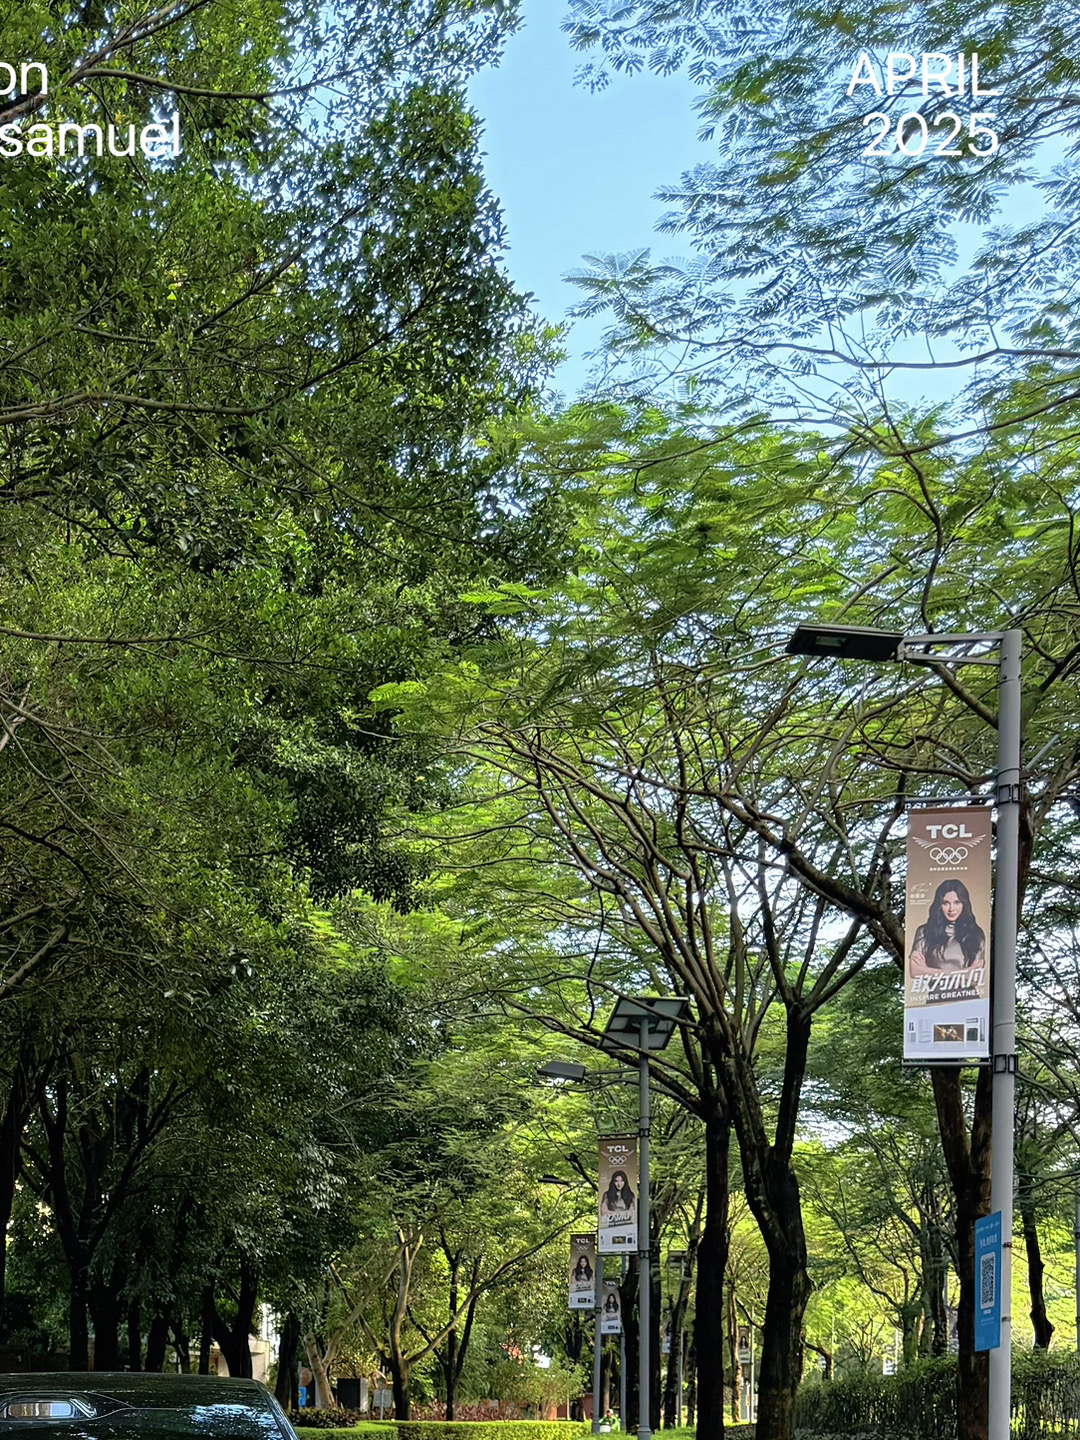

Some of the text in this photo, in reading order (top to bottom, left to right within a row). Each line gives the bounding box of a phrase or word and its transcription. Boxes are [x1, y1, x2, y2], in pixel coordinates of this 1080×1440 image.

[926, 824, 972, 839] TCL
[911, 967, 985, 993] 敢为不凡
[910, 989, 985, 1003] INSPIRE GREATNESS
